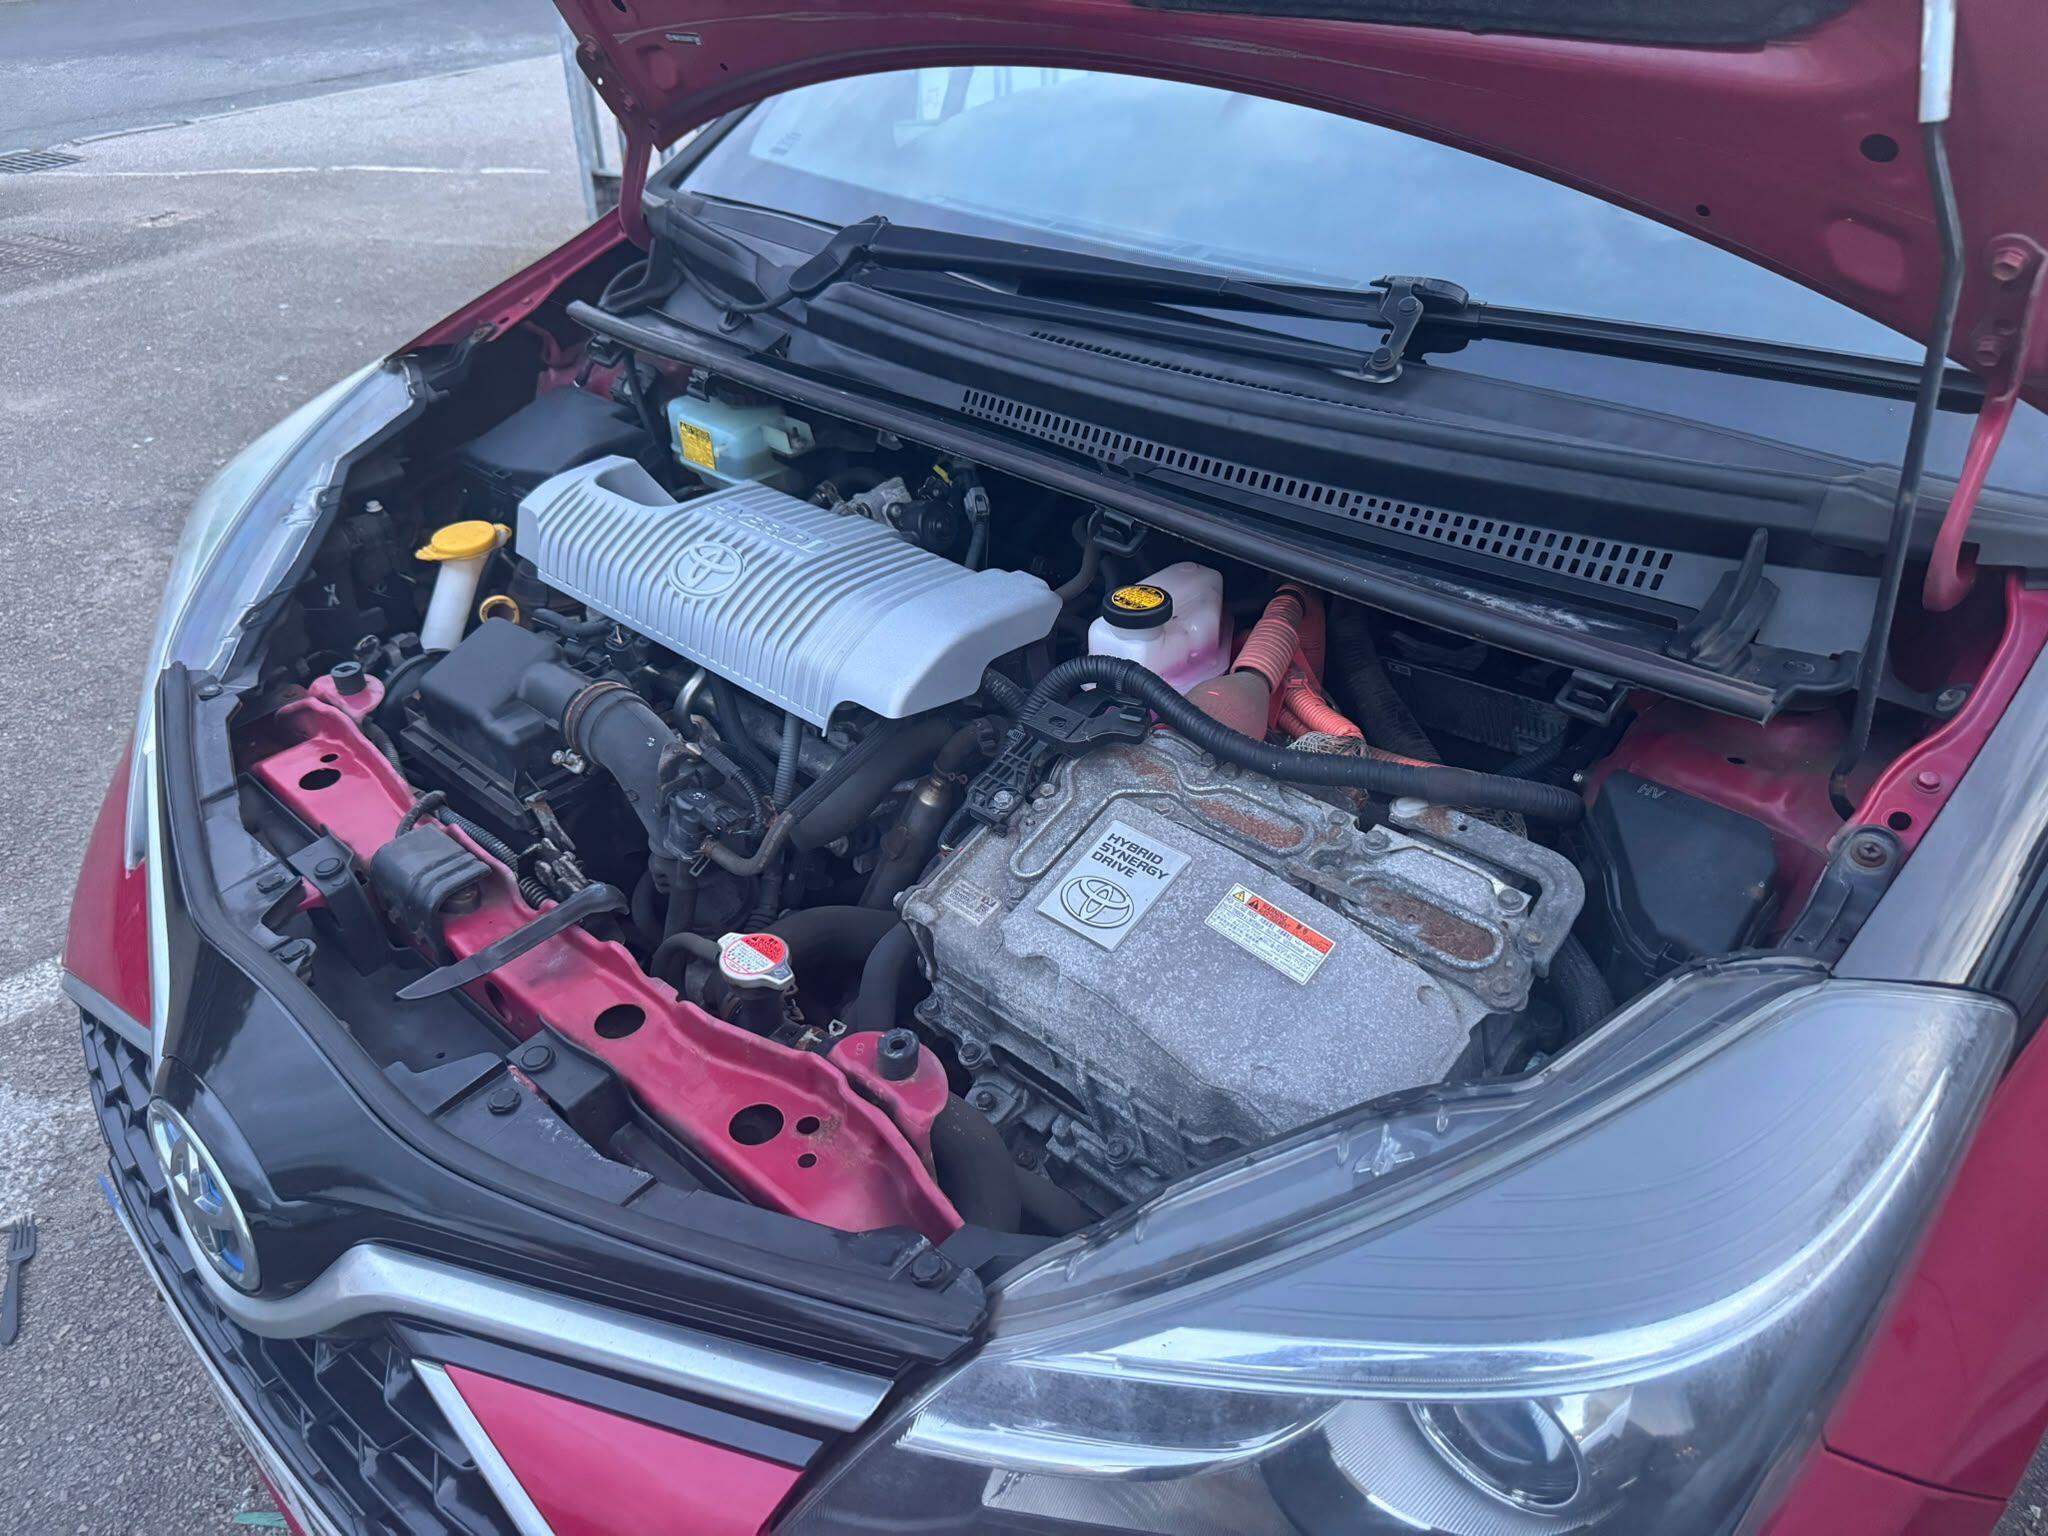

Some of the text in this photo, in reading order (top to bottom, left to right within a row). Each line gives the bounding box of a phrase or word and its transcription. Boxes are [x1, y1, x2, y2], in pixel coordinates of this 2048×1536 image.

[1091, 851, 1138, 878] DRIVE
[1098, 842, 1170, 880] SYNERGY
[1107, 833, 1163, 865] HYBRID
